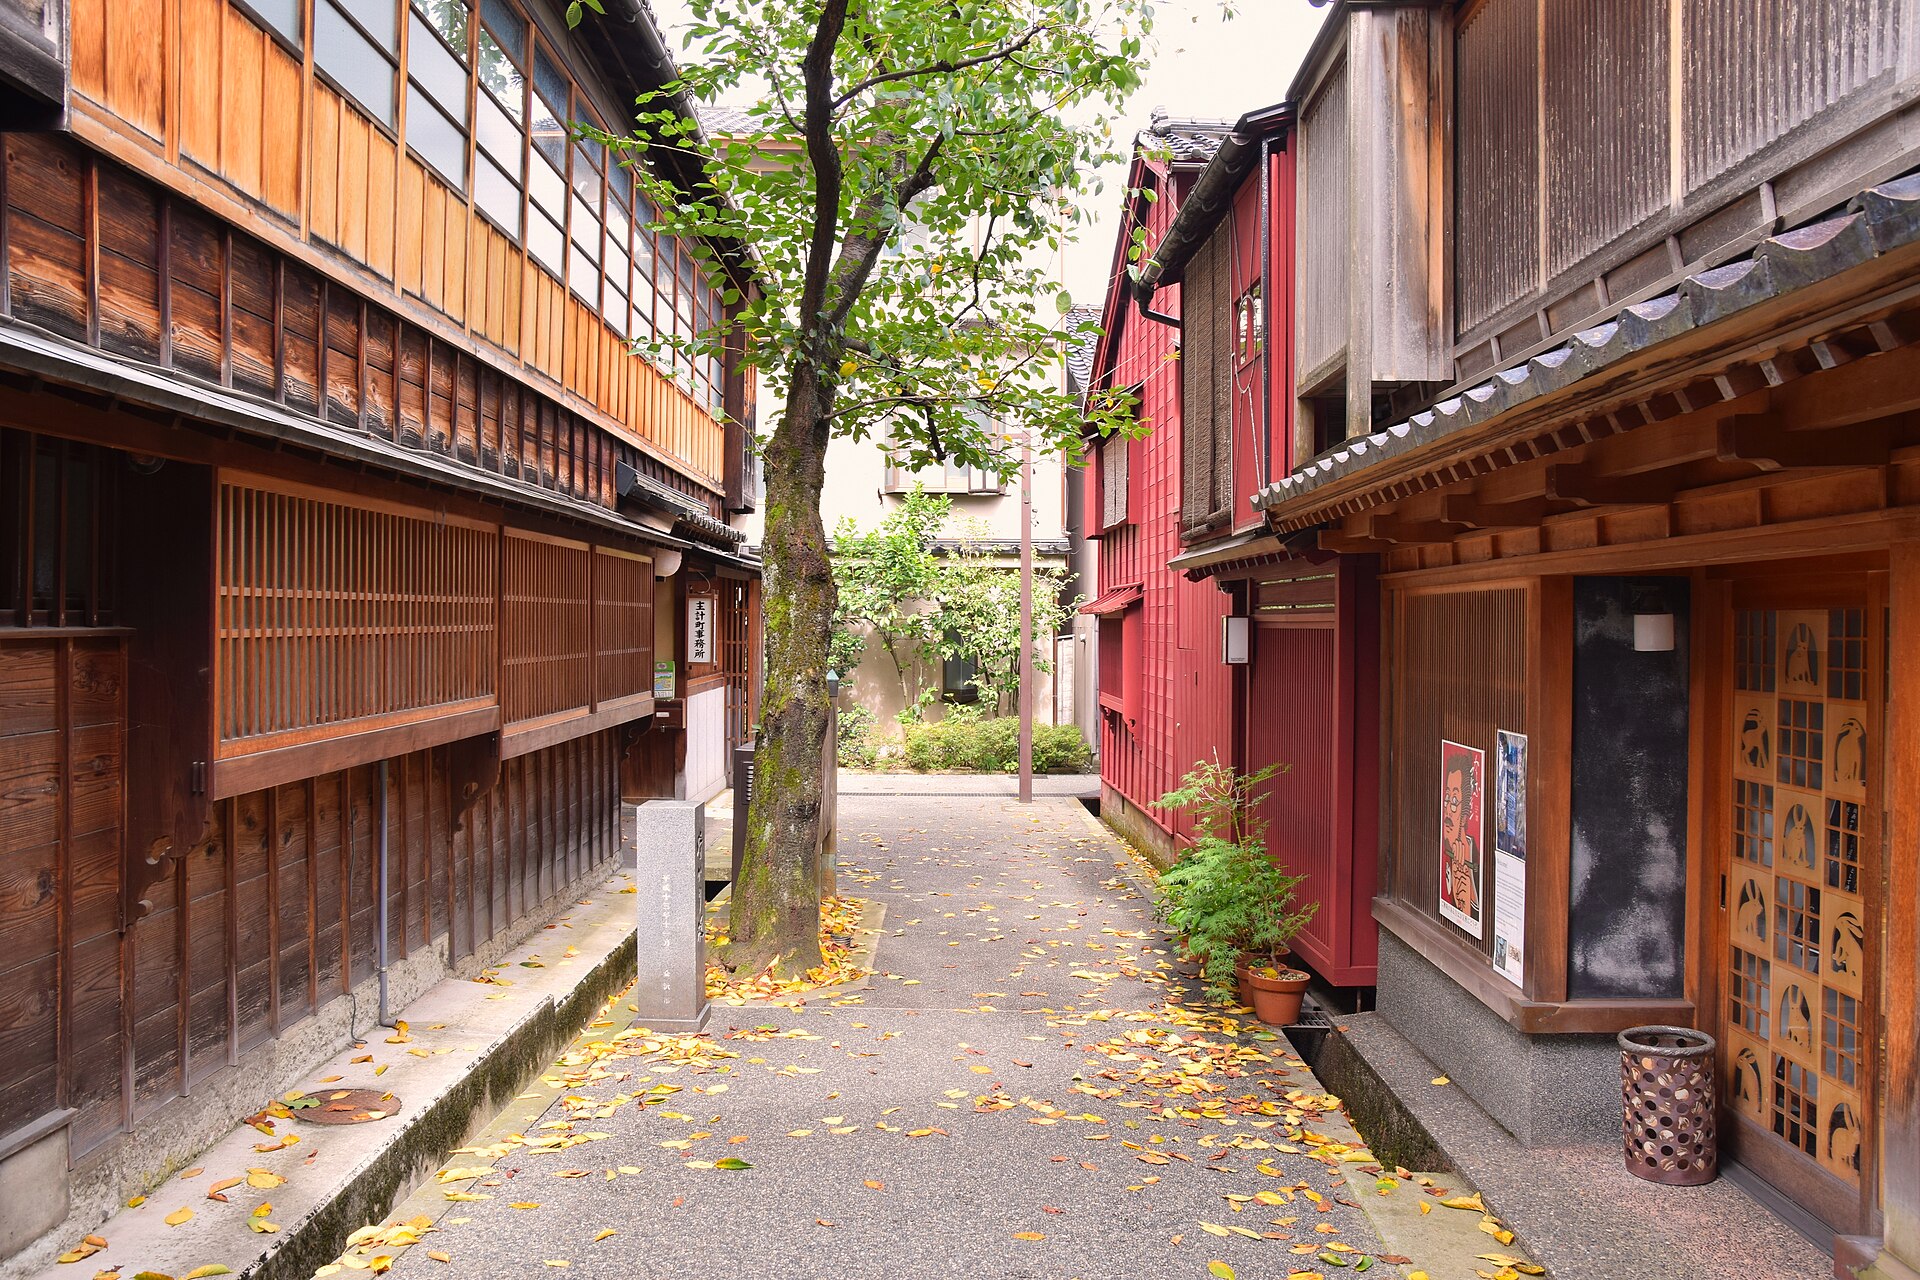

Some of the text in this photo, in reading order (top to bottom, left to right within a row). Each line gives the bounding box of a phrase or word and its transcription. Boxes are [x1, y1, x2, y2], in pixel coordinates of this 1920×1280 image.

[694, 601, 705, 658] 主計町事務所
